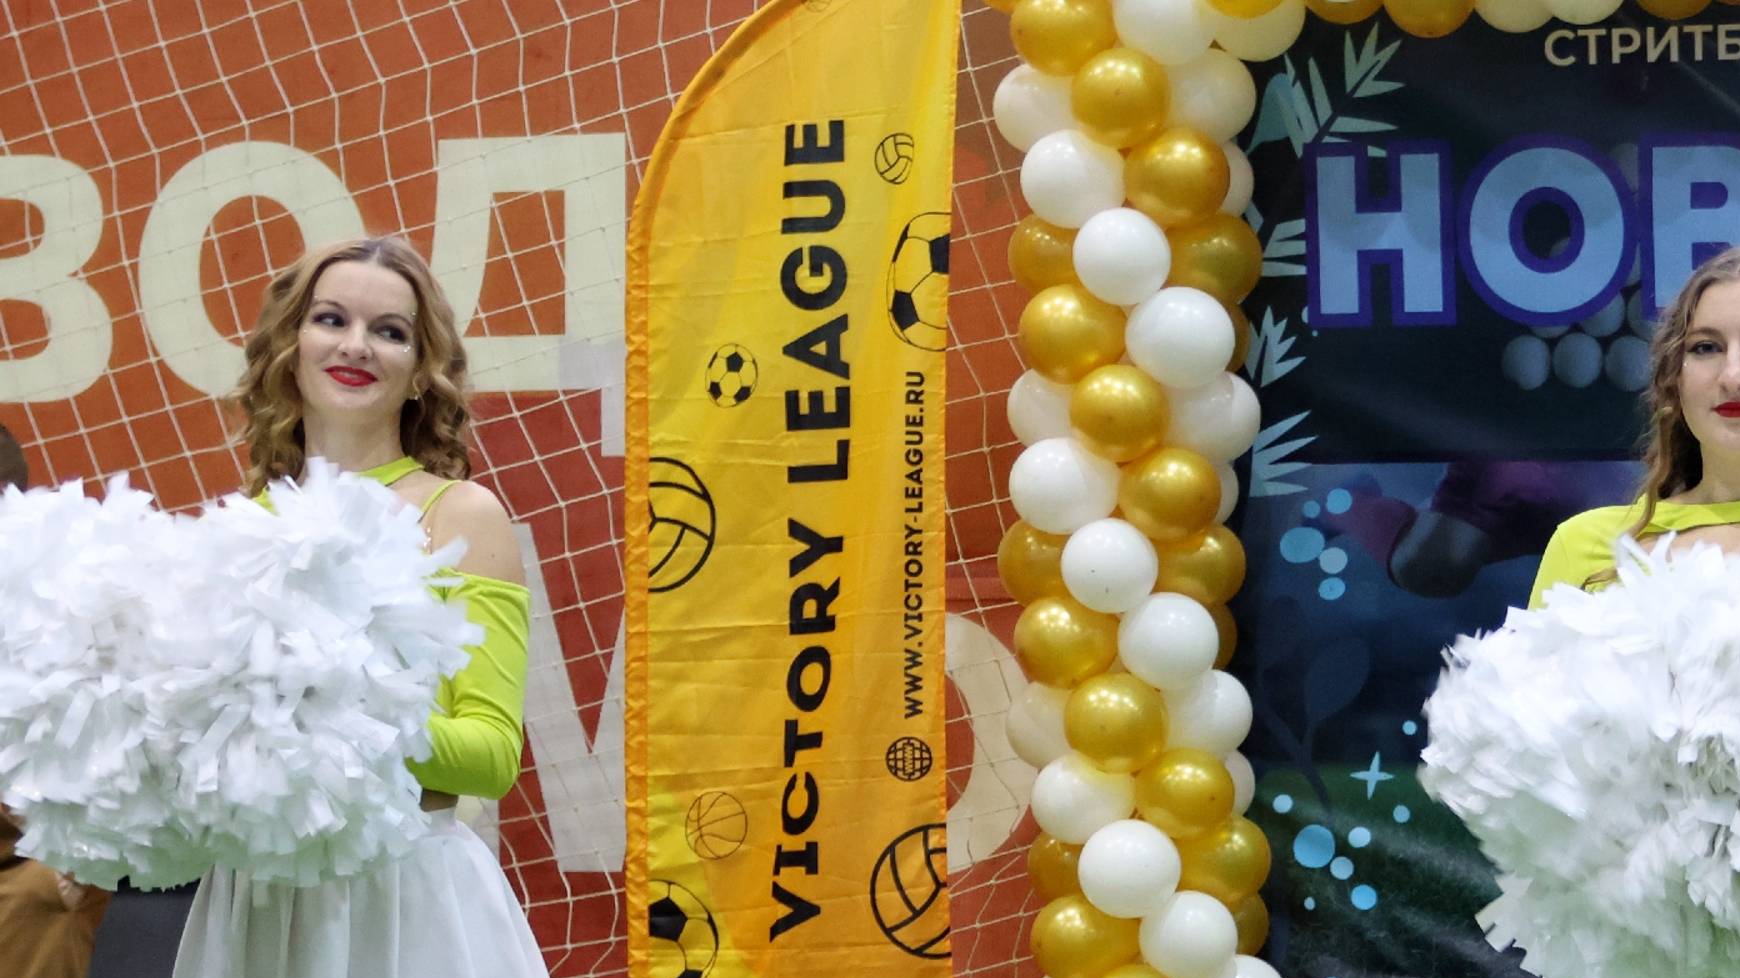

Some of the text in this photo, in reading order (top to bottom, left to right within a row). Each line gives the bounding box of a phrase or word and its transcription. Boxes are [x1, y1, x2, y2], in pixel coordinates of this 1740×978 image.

[769, 119, 851, 943] VICTORY LEAGUE
[903, 371, 925, 719] WWW.VICTORY-LEAGUE.RU
